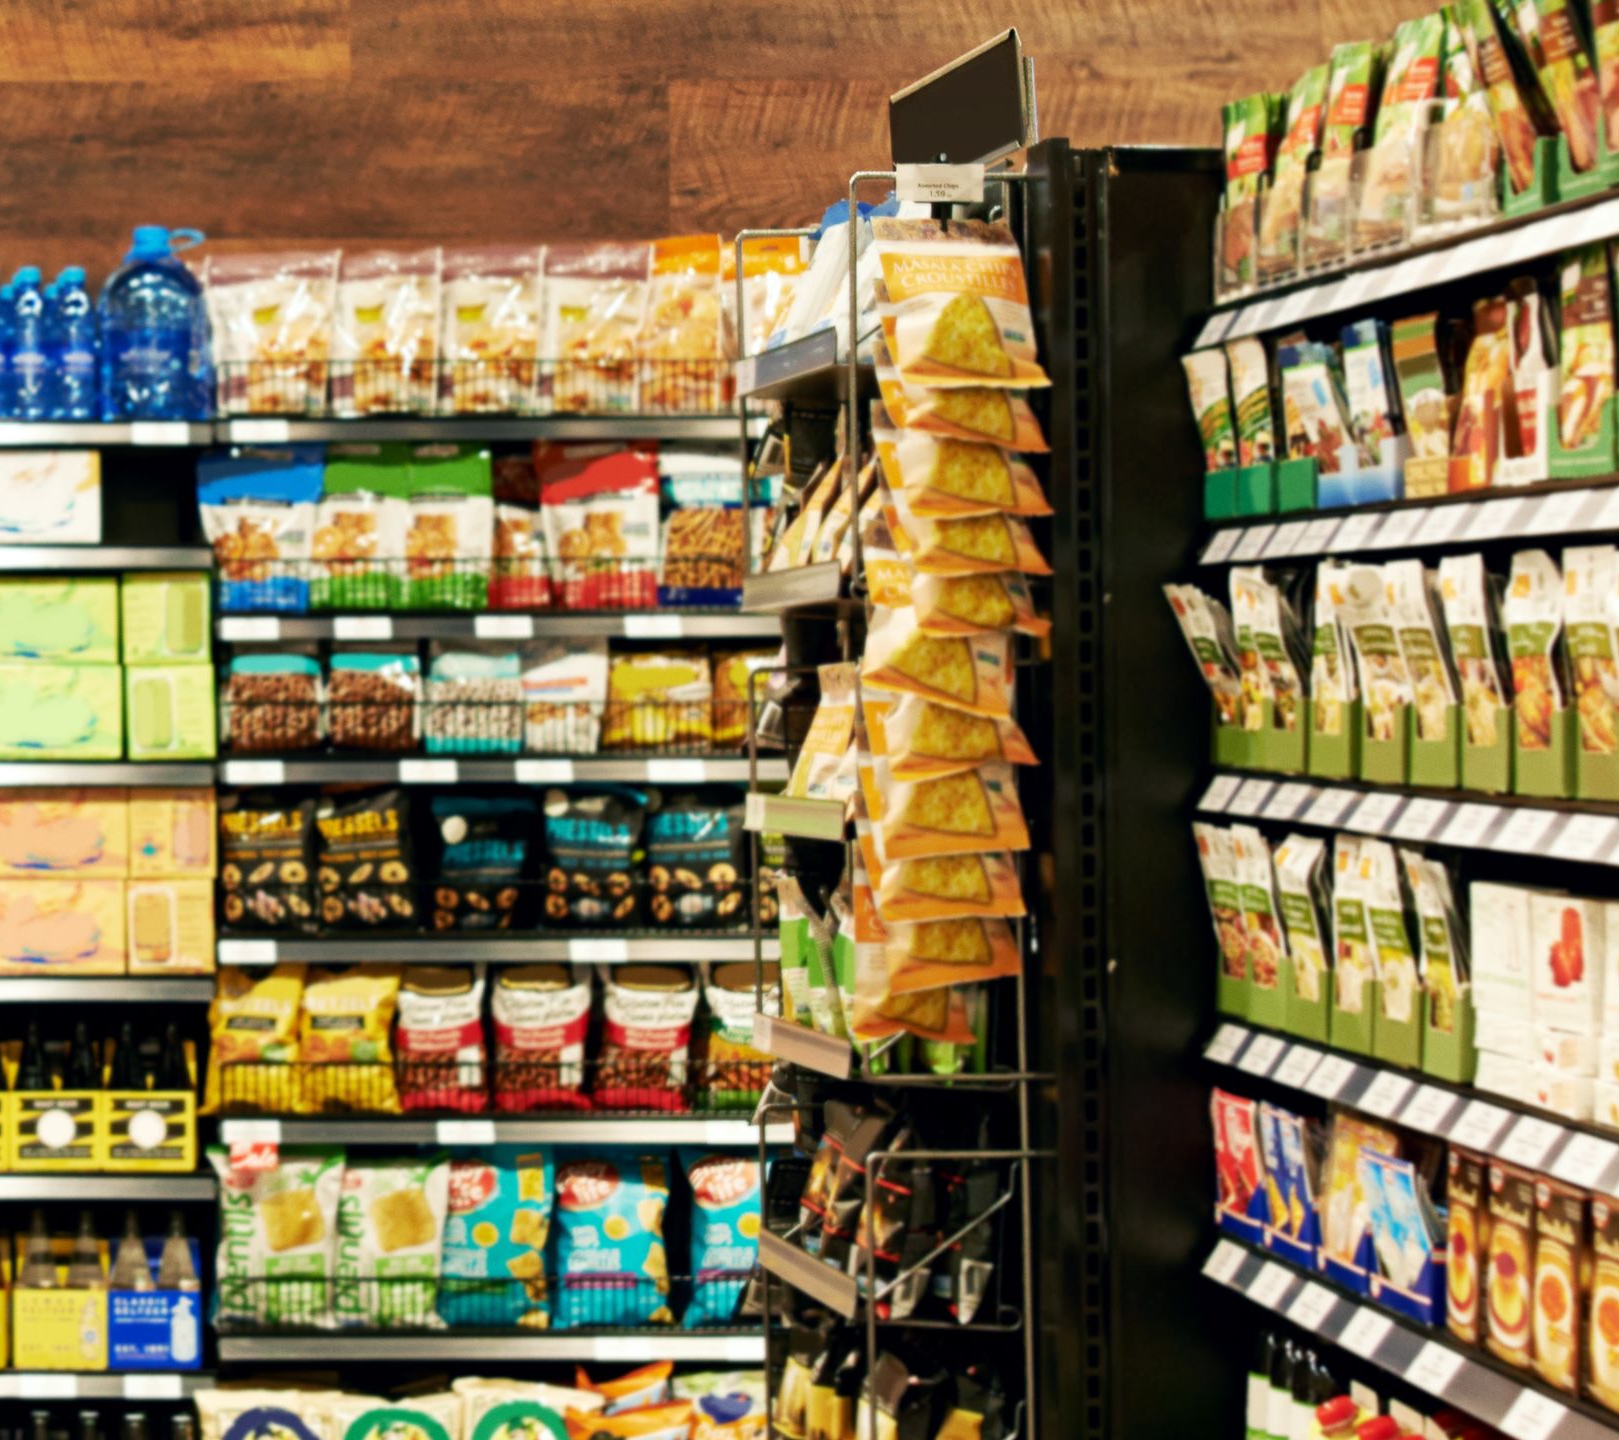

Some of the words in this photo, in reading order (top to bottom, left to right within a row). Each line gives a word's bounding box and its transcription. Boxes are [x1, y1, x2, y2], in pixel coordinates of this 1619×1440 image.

[893, 261, 960, 275] MASALA
[967, 261, 1018, 277] CHIPS
[901, 270, 1015, 290] CROUSTILLES
[114, 1297, 168, 1306] CLASSIC
[114, 1306, 168, 1316] SELTZER
